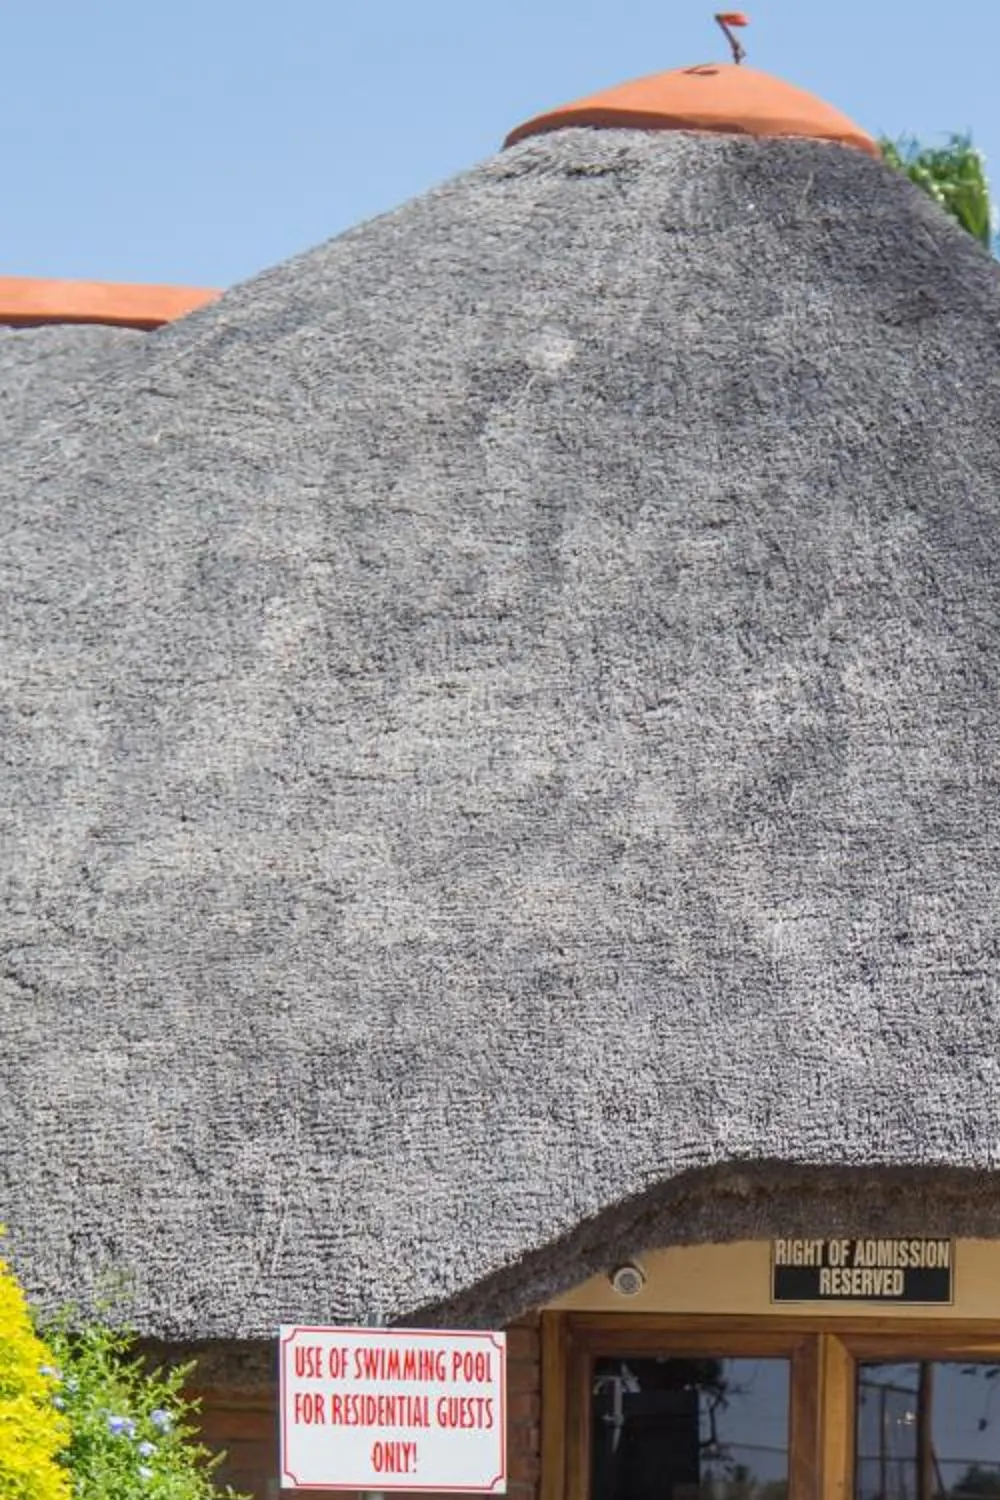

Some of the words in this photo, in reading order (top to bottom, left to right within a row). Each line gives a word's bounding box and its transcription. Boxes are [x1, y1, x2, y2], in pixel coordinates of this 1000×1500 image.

[775, 1239, 824, 1265] RIGHT
[828, 1240, 850, 1266] OF
[854, 1240, 950, 1268] ADMISSION
[819, 1268, 904, 1296] RESERVED
[294, 1346, 323, 1378] USE
[329, 1347, 349, 1378] OF
[354, 1347, 447, 1382] SWIMMING
[452, 1351, 492, 1383] POOL
[295, 1393, 325, 1425] FOR
[332, 1394, 430, 1428] RESIDENTIAL
[436, 1398, 493, 1429] GUESTS
[372, 1441, 417, 1473] ONLY!
